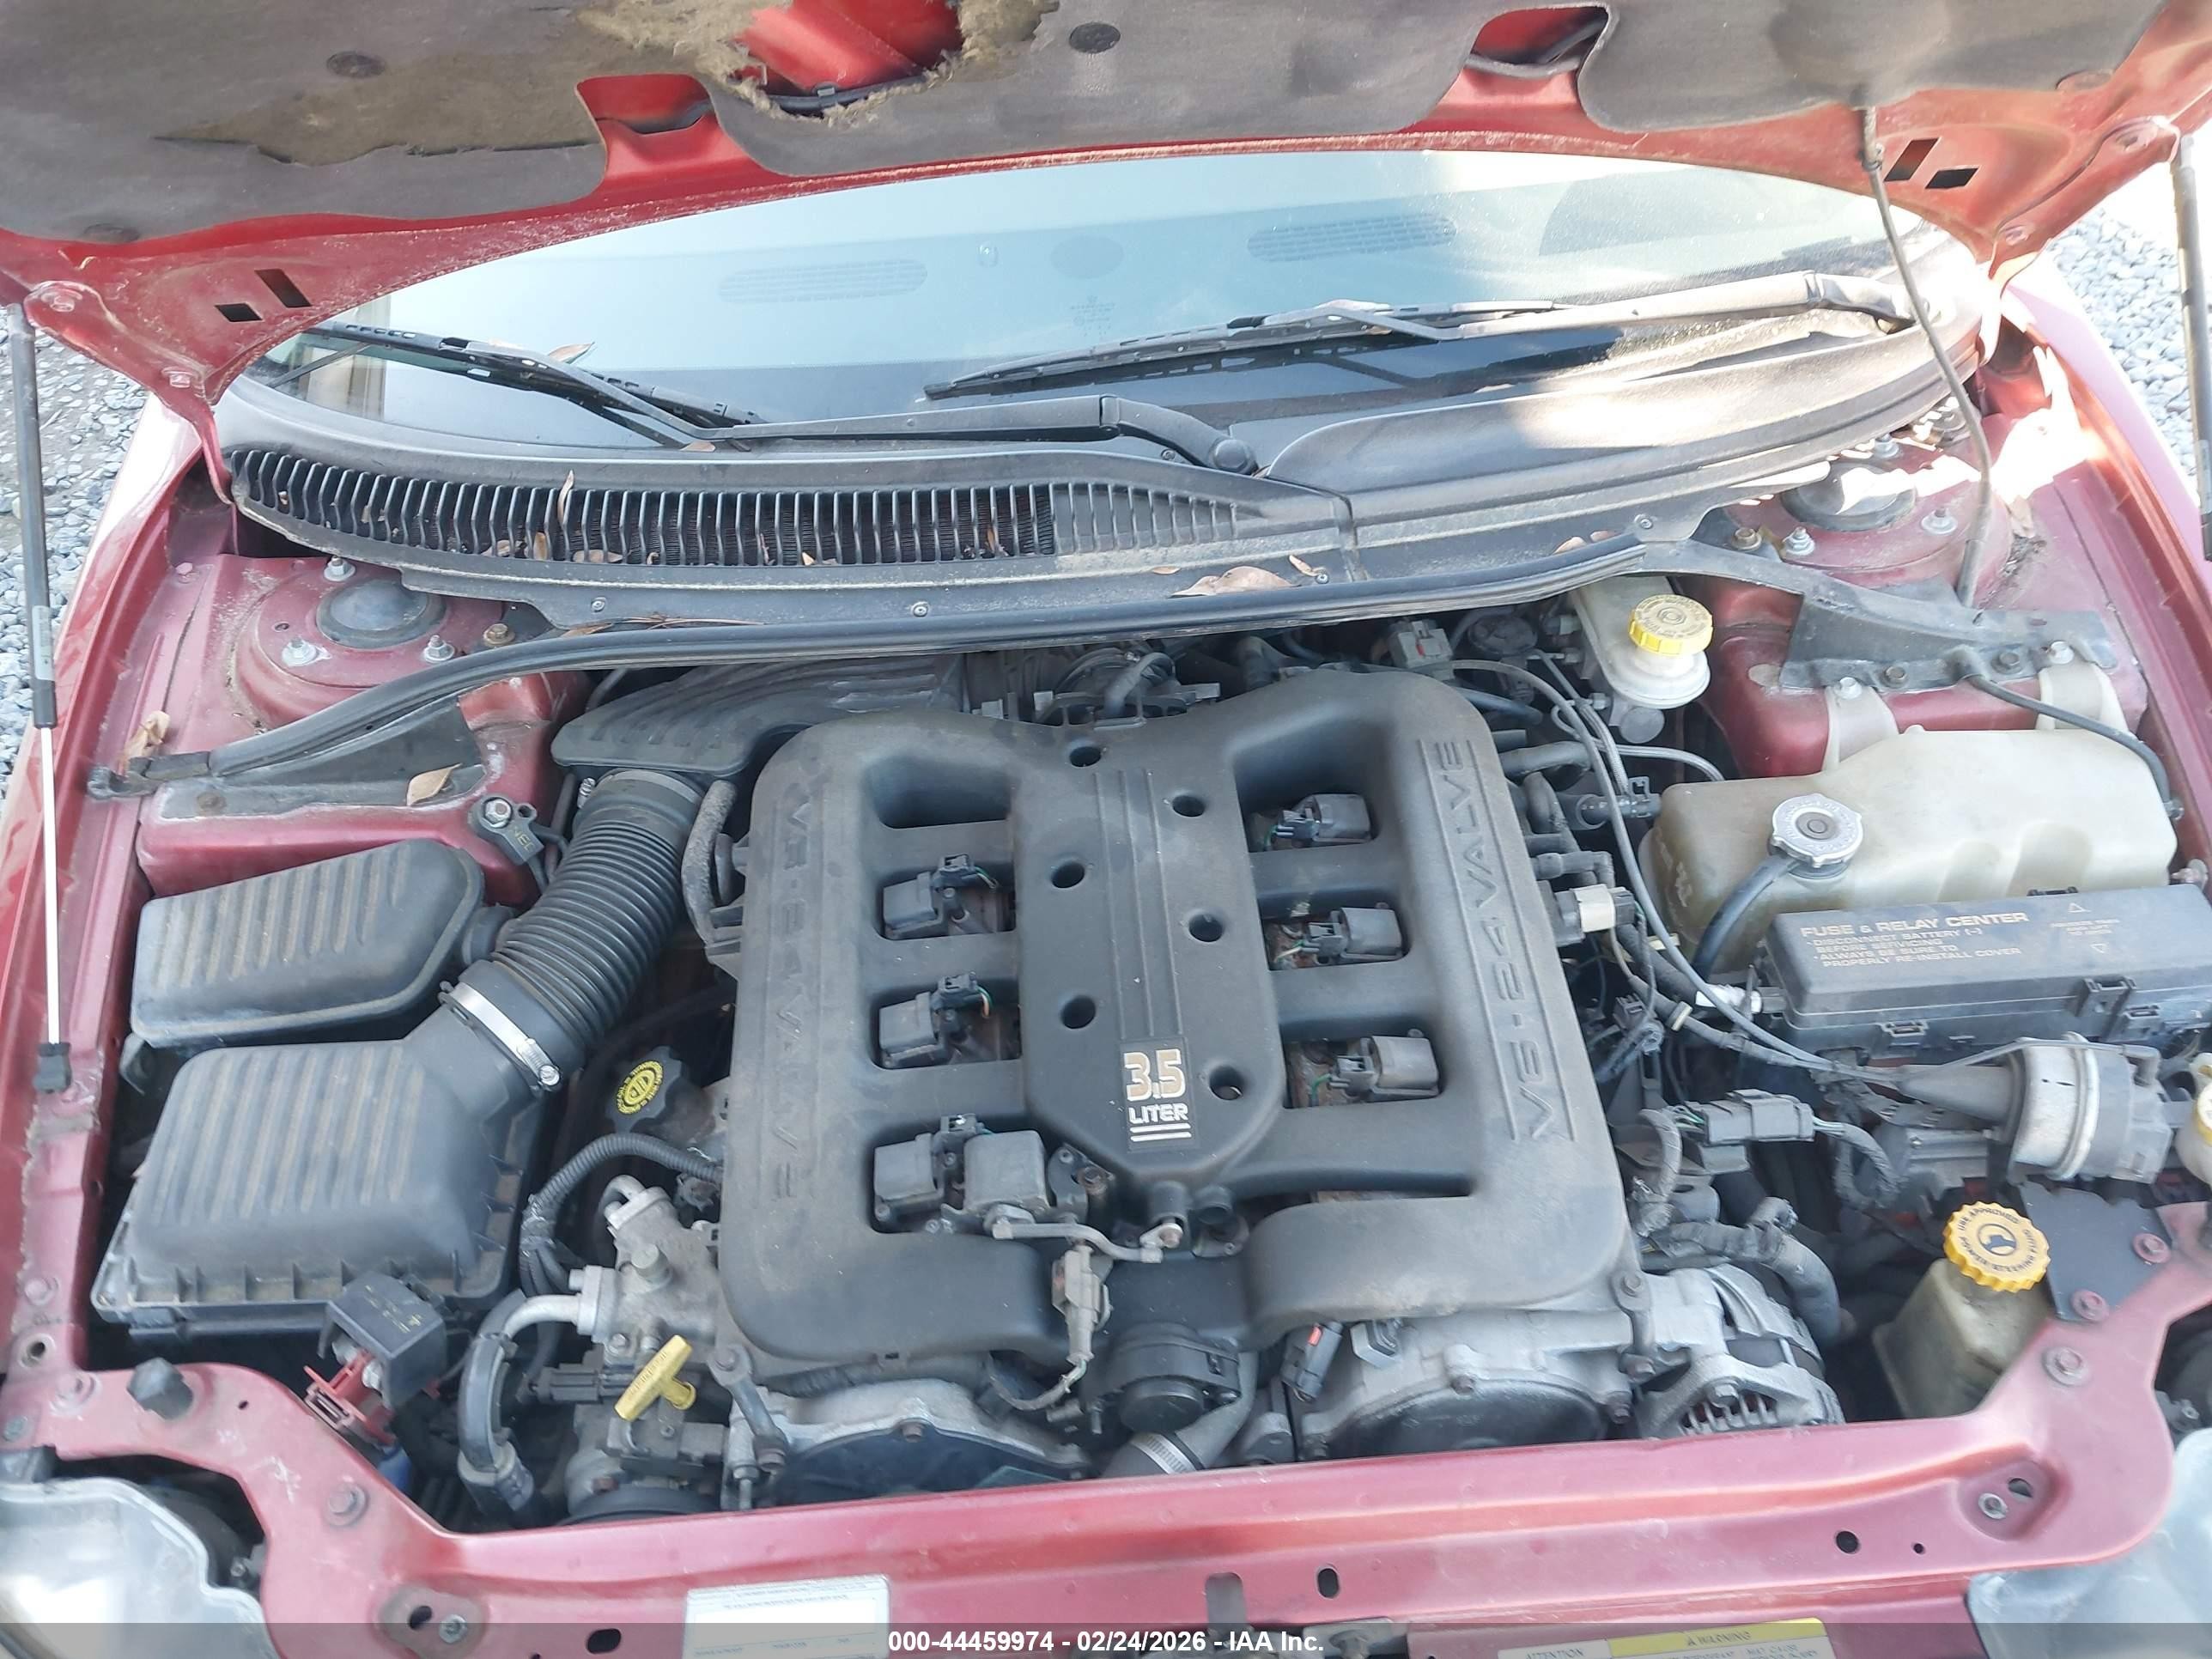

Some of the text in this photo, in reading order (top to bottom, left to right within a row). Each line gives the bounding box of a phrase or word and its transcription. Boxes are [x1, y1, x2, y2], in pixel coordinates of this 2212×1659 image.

[1435, 740, 1500, 910] VALVE
[1800, 912, 2029, 937] FUSE & RELAY CENTER
[1813, 933, 1896, 945] DISCONNECT
[1902, 929, 1960, 940] BATTERY
[1815, 938, 1942, 953] BEFORE SERVICING
[1820, 944, 1959, 960] ALWAYS BE SURE TO
[1822, 947, 2022, 968] PROPERLY RE-INSTALL COVER
[1123, 1048, 1186, 1102] 3.5
[1128, 1103, 1188, 1124] LITER
